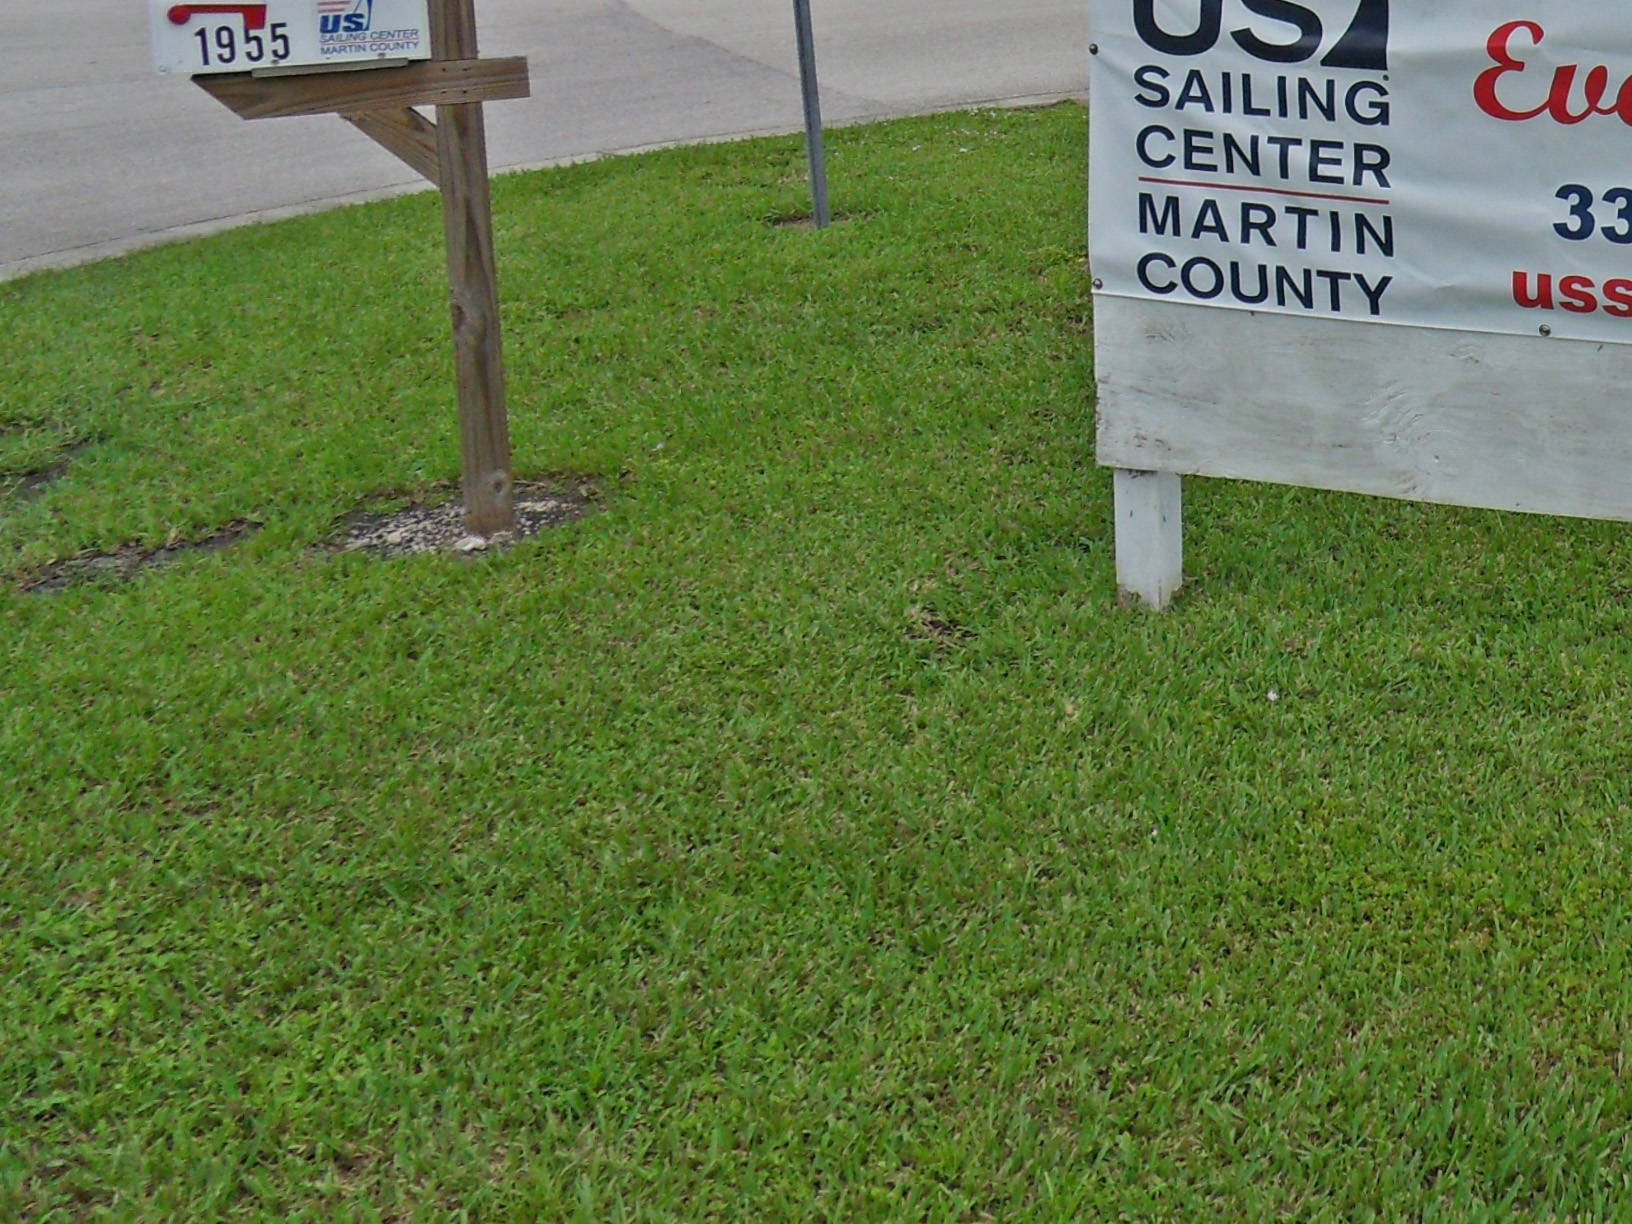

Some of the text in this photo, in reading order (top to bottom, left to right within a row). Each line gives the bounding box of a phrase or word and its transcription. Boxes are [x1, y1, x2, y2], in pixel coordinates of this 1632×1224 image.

[194, 22, 290, 66] 1955
[319, 28, 419, 43] SAILING CENTER
[320, 13, 366, 34] US
[320, 41, 419, 55] MARTIN COUNTY
[1133, 64, 1391, 127] SAILING
[1135, 125, 1391, 189] CENTER
[1138, 191, 1395, 259] MARTIN
[1136, 251, 1394, 316] COUNTY
